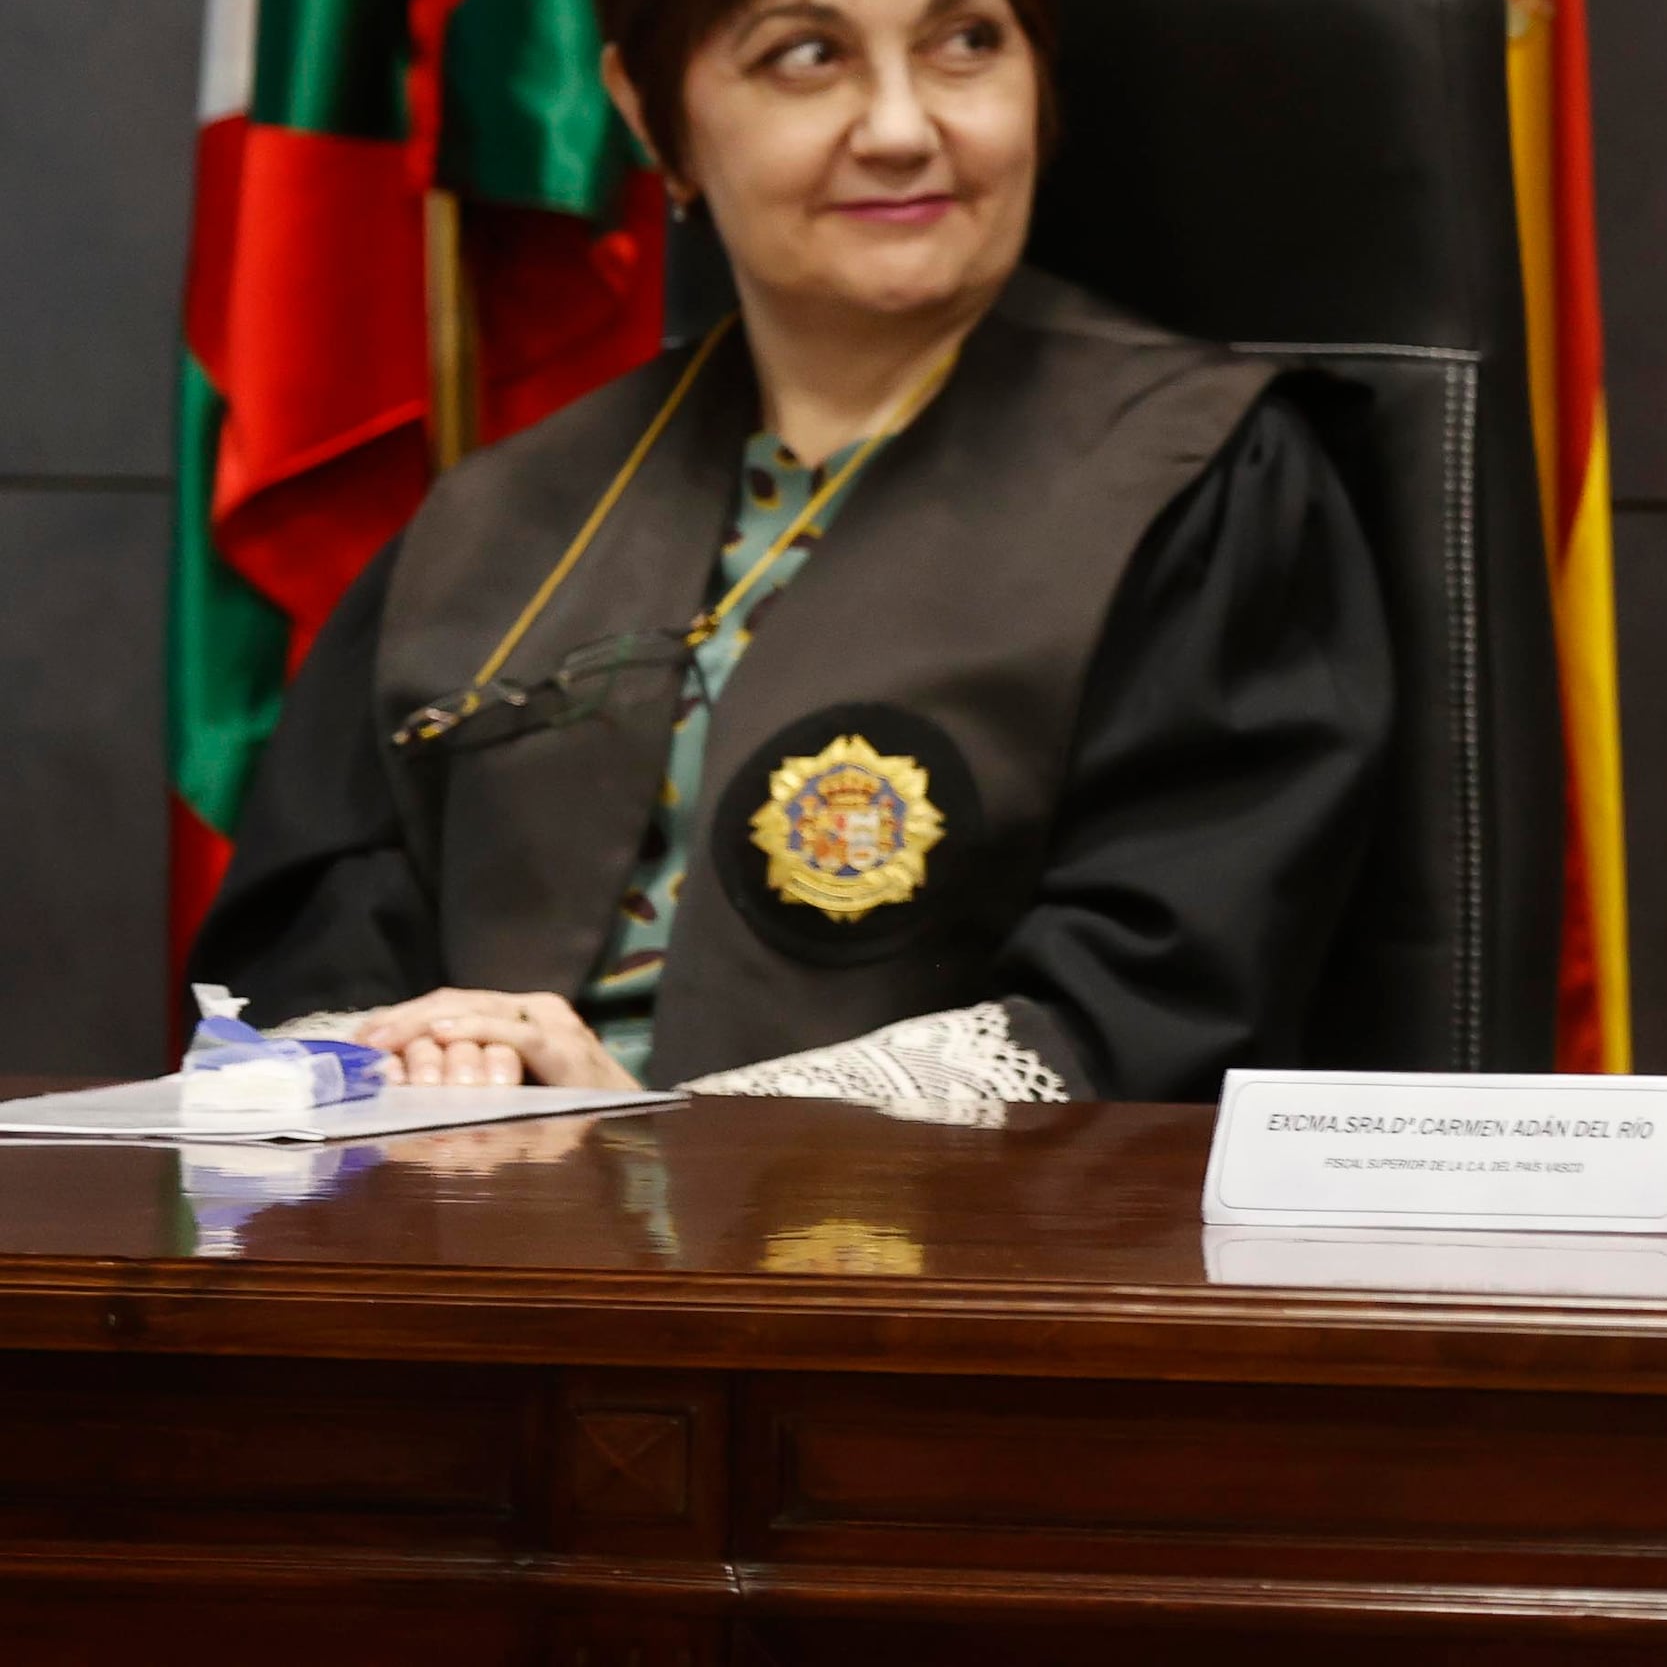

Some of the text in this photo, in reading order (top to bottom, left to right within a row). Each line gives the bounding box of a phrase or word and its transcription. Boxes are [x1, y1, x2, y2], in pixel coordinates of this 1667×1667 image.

[1513, 1115, 1569, 1137] ADÁN
[1574, 1120, 1611, 1138] DEL
[1617, 1116, 1655, 1139] RÍO
[1366, 1158, 1426, 1170] SUPERIOR
[1429, 1159, 1446, 1171] DE
